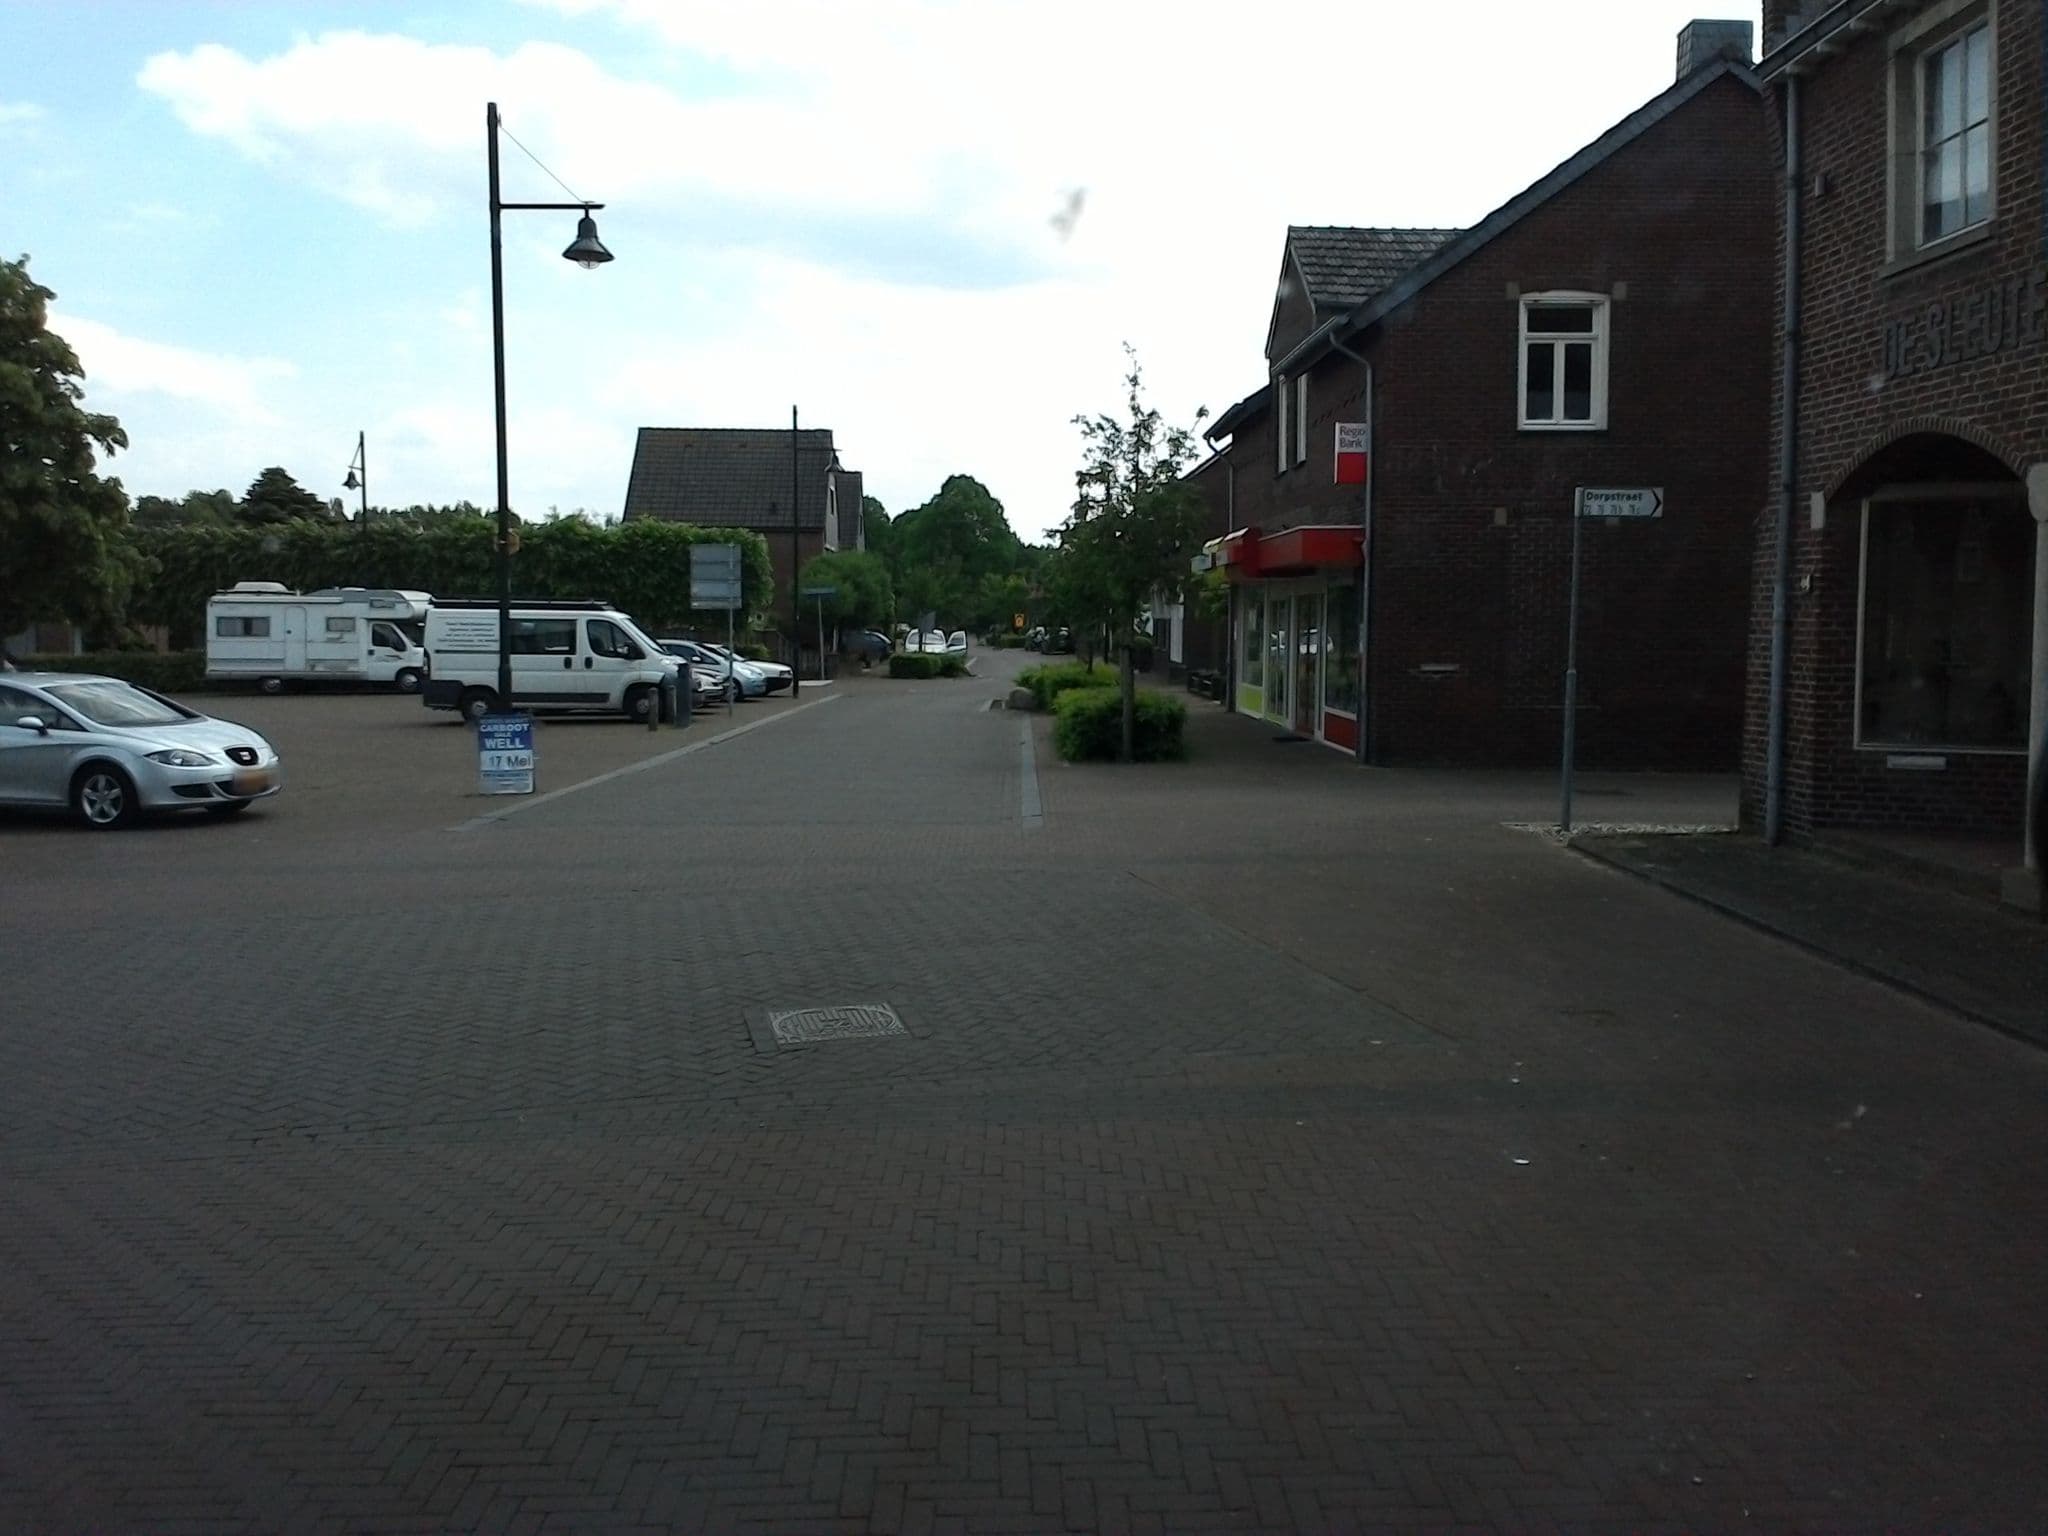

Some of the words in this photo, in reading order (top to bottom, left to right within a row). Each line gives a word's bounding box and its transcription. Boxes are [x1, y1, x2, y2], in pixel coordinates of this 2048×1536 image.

[1882, 312, 1915, 378] DE
[1340, 425, 1366, 438] Regio
[1340, 437, 1363, 448] Bank
[1586, 491, 1642, 502] Dorpstraat
[480, 723, 530, 732] CARBOOT
[484, 738, 525, 749] WELL
